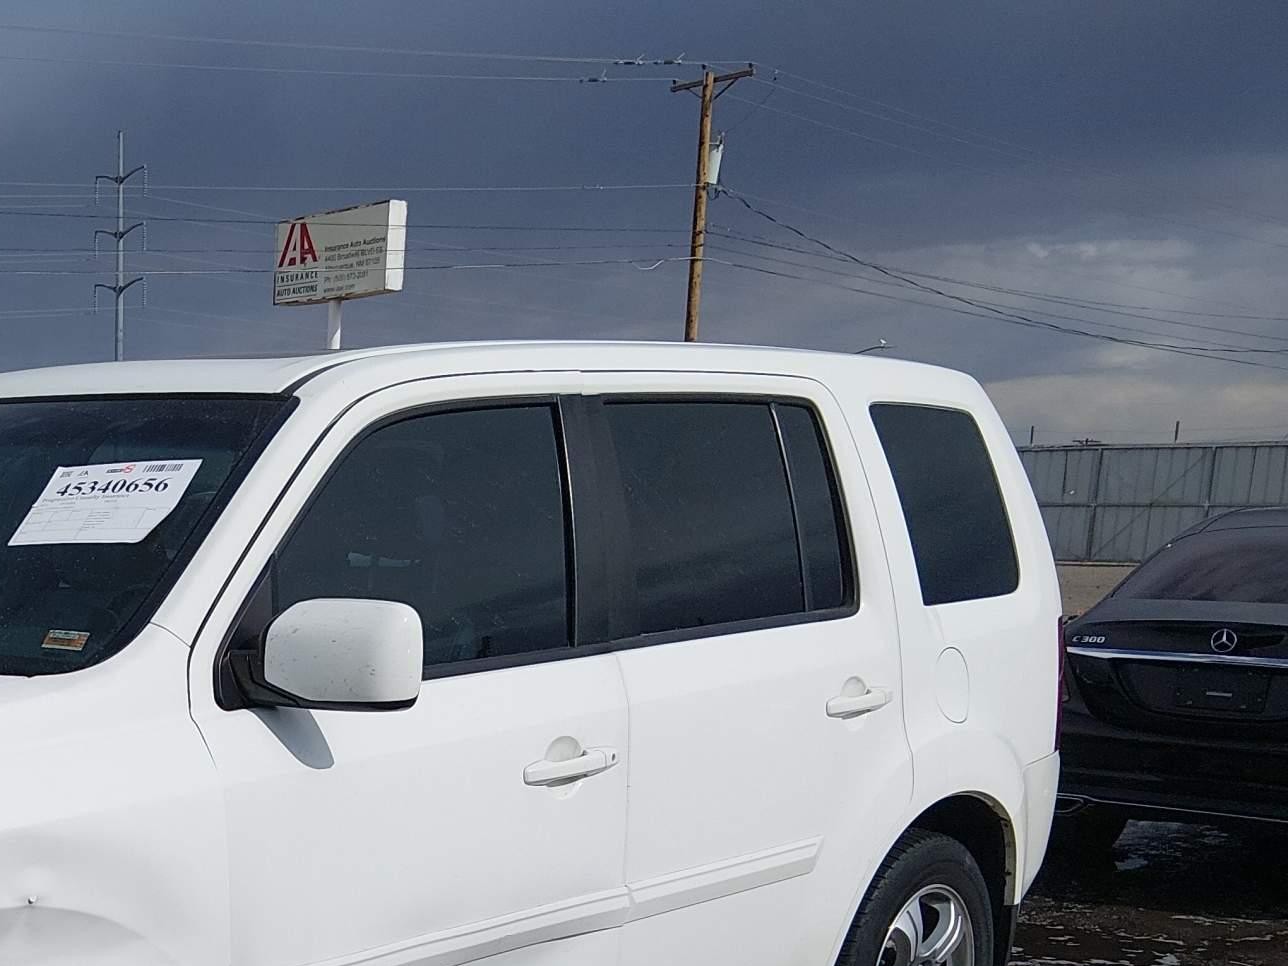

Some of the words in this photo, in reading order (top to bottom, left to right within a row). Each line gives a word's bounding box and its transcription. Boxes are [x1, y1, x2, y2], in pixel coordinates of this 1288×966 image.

[350, 240, 362, 248] Auto
[363, 236, 386, 245] Auctions
[276, 271, 318, 285] INSURANCE
[276, 287, 291, 297] AUTO
[292, 284, 318, 295] AUCTIONS
[56, 478, 172, 496] 45340656
[1081, 635, 1106, 644] 300
